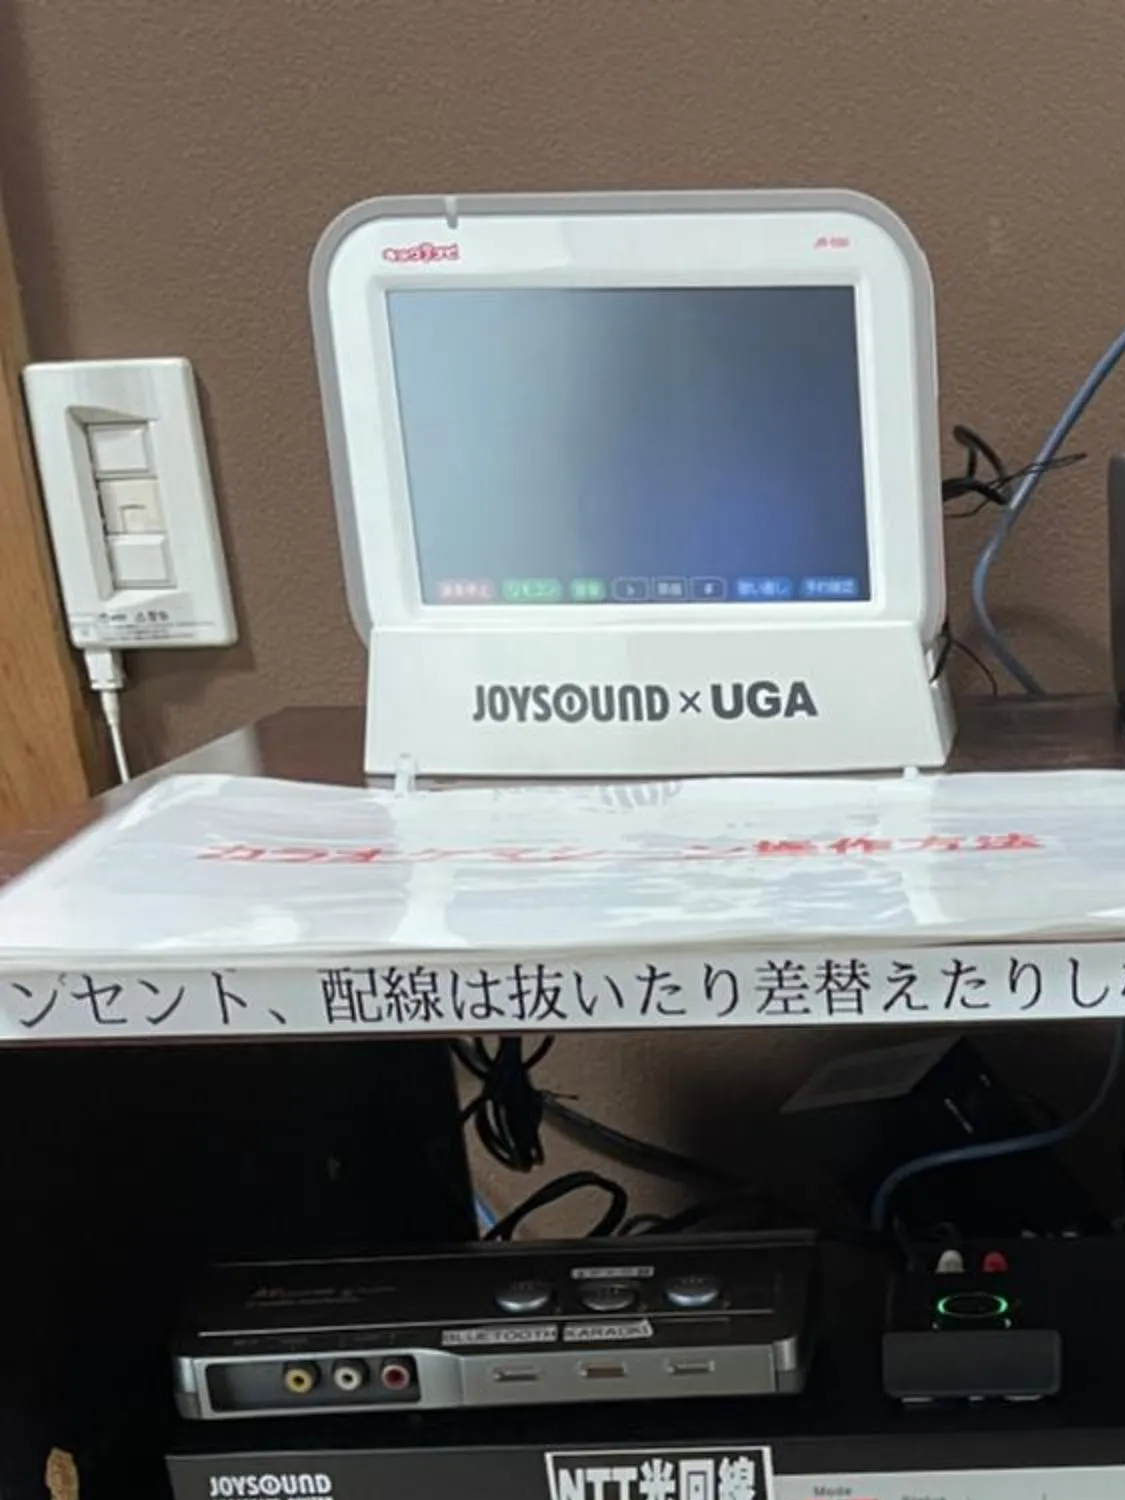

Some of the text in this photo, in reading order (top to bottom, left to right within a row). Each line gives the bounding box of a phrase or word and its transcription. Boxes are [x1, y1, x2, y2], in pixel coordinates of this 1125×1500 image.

[472, 683, 670, 723] JOYSOUND
[711, 680, 819, 720] UGA
[209, 1473, 333, 1497] JOYSOUND
[813, 1485, 852, 1497] Mode
